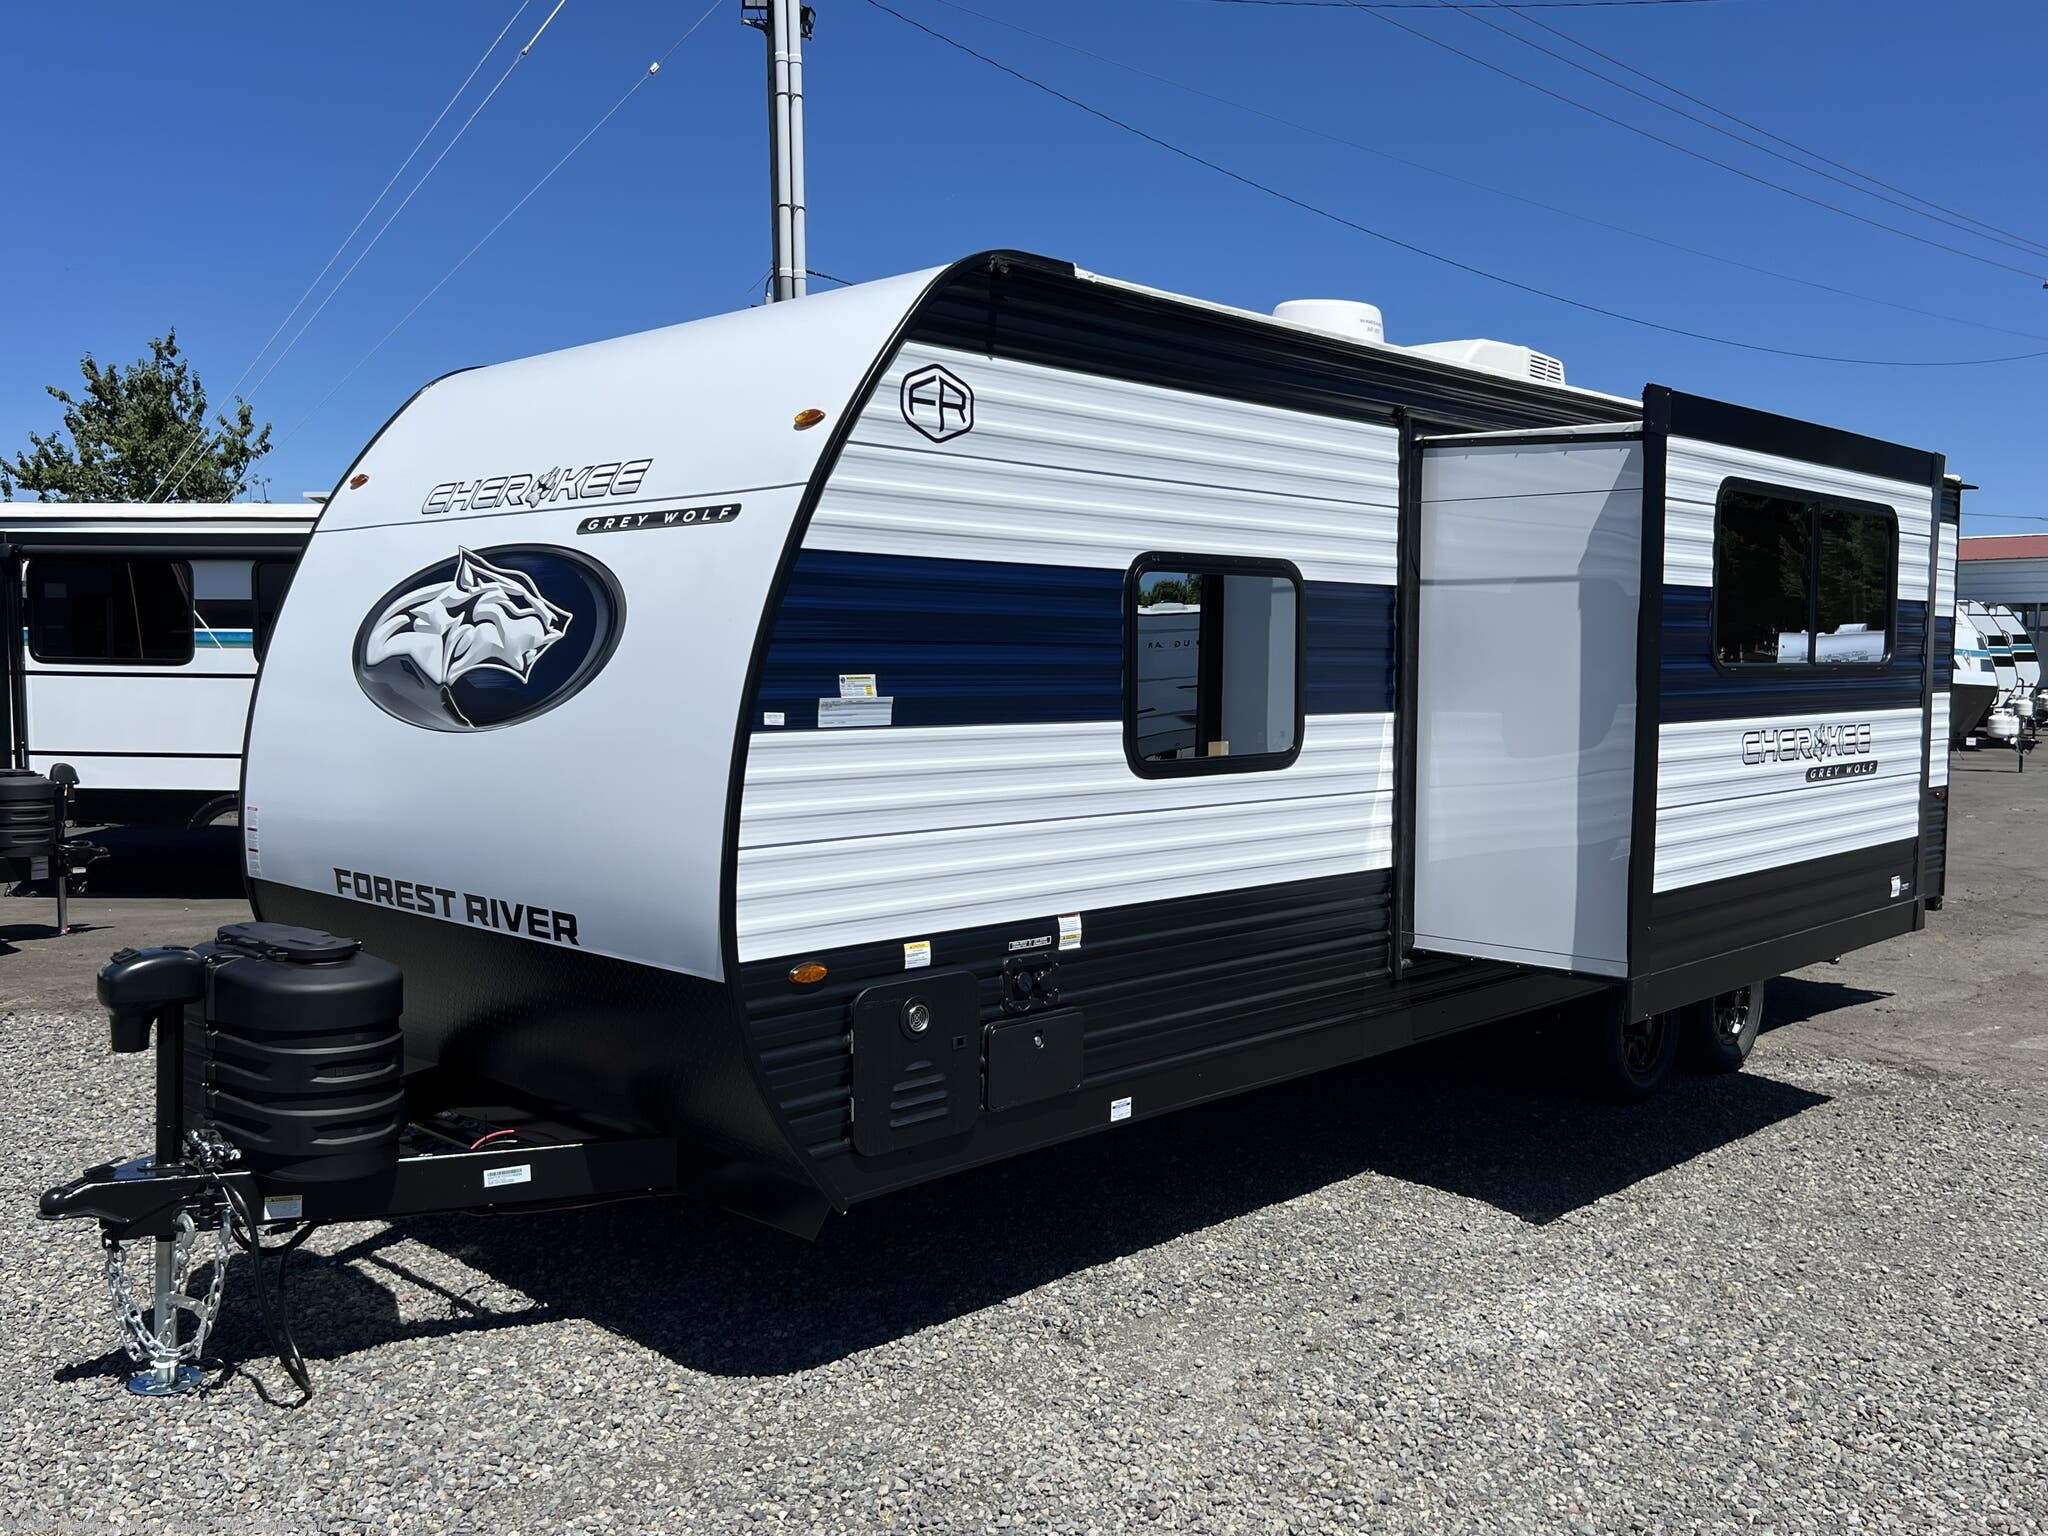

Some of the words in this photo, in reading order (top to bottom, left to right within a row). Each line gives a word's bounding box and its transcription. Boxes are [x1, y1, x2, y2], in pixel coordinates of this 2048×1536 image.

[421, 457, 654, 515] CHEROKEE
[587, 514, 649, 532] GREY
[663, 507, 731, 525] WOLF
[1742, 723, 1871, 766] CHEROKEE
[1809, 766, 1840, 780] GREY
[1846, 762, 1876, 775] WOLF
[333, 867, 456, 919] FOREST
[463, 892, 580, 947] RIVER
